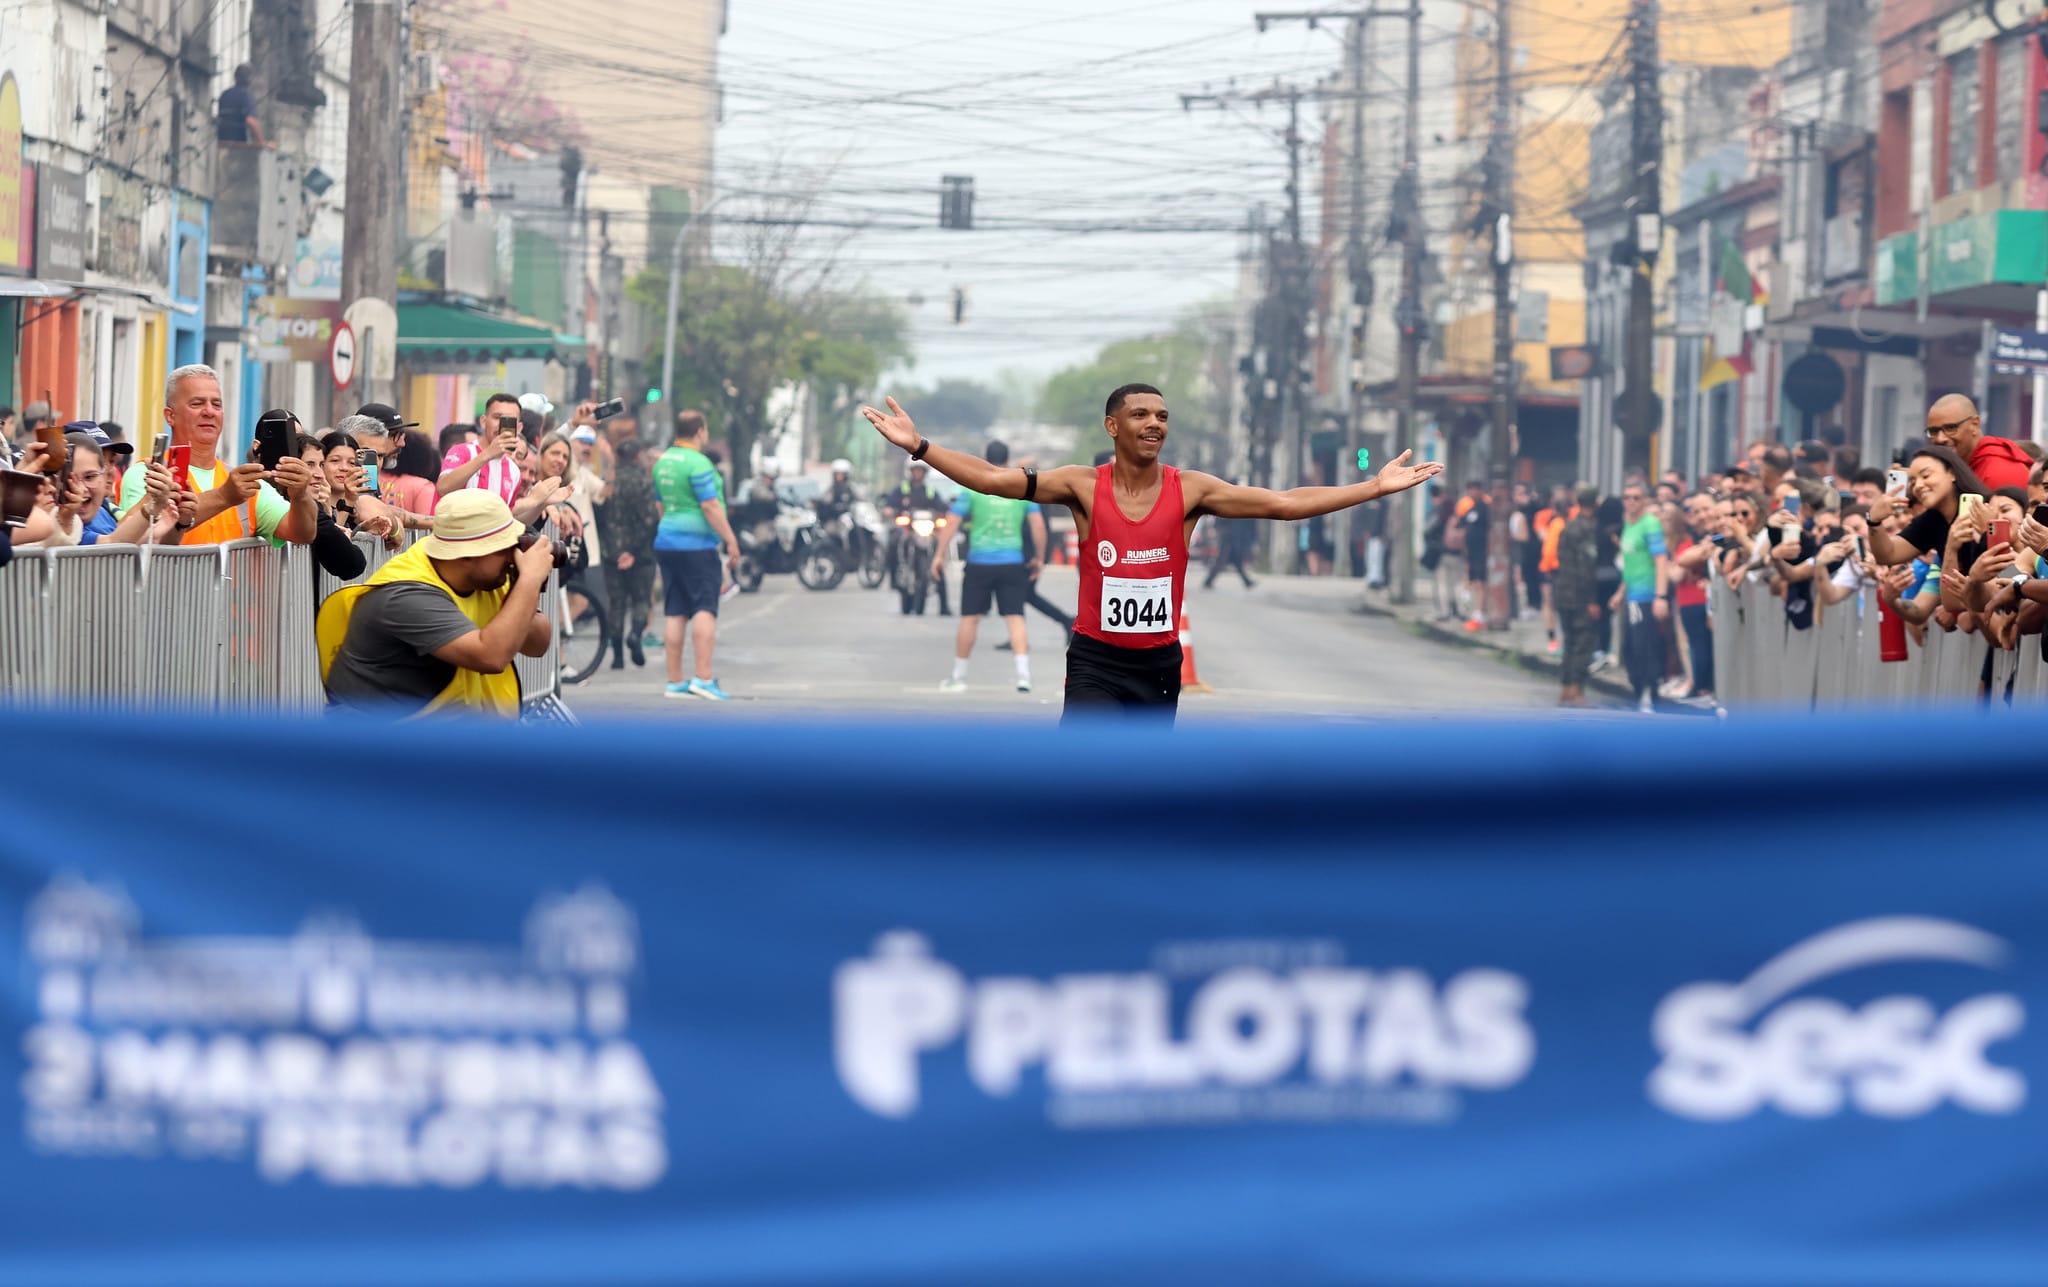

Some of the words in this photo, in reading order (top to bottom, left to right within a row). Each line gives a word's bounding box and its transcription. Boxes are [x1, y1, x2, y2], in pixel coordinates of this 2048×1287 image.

[1127, 547, 1167, 559] RUNNERS
[1108, 597, 1168, 627] 3044
[101, 1031, 663, 1111] MARATONA
[967, 966, 1536, 1098] PELOTAS
[258, 1106, 668, 1188] PELOTAS
